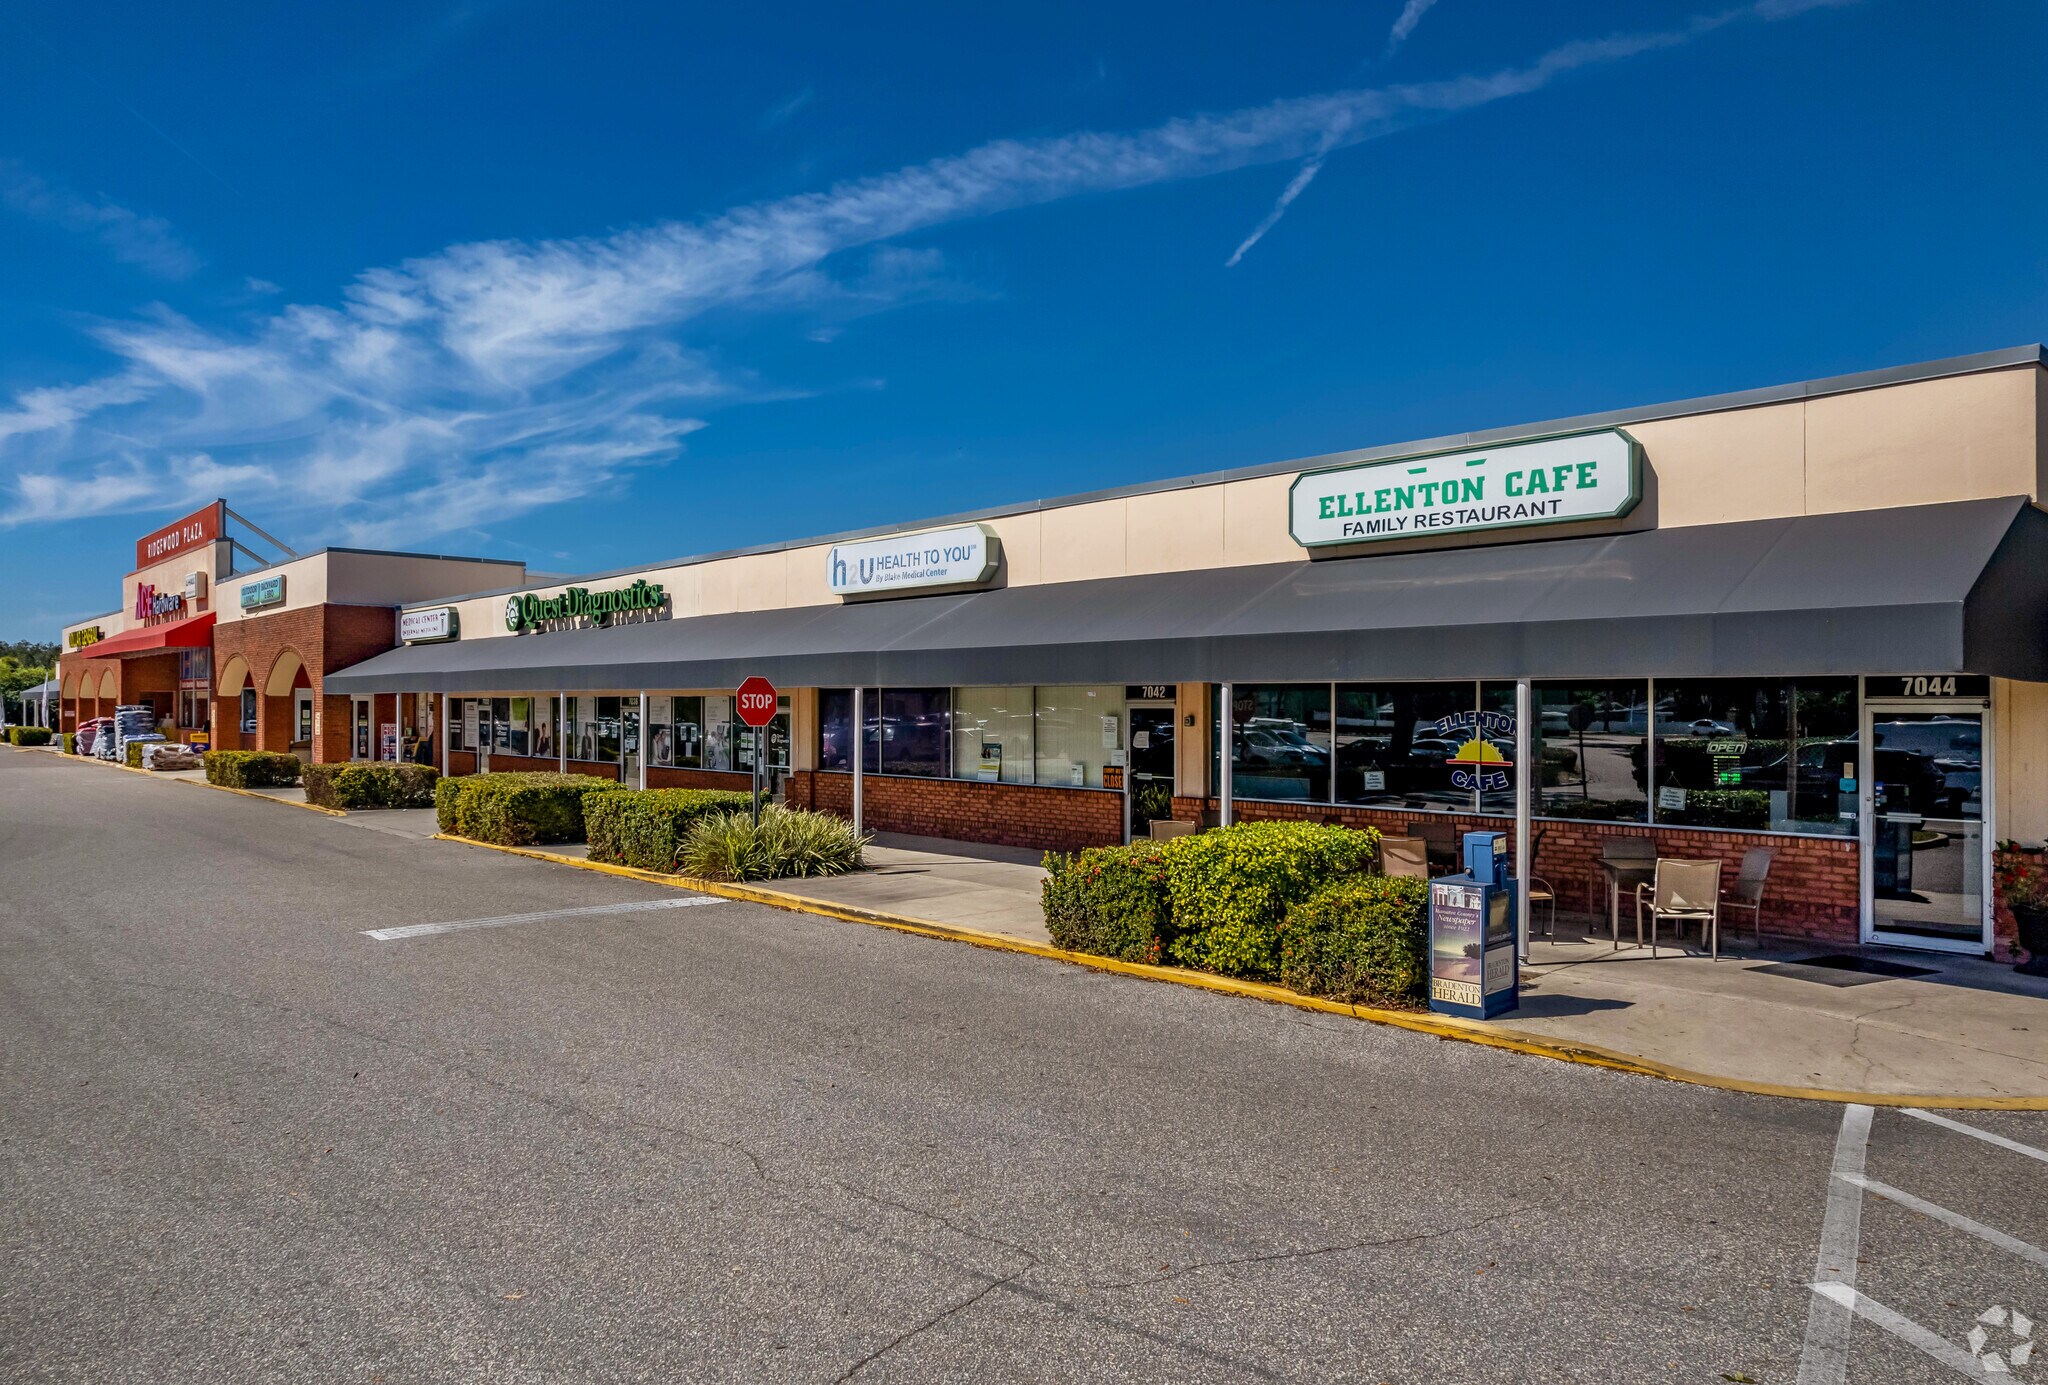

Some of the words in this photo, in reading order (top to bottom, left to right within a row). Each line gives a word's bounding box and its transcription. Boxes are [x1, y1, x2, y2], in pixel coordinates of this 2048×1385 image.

[1318, 475, 1486, 520] ELLENTON
[1505, 460, 1598, 497] CAFE
[1343, 515, 1408, 537] FAMILY
[1413, 499, 1563, 529] RESTAURANT
[147, 531, 180, 558] RIDGEWOOD
[183, 522, 203, 543] PLAZA
[876, 552, 921, 570] HEALTH
[923, 549, 940, 565] TO
[943, 545, 971, 562] YOU
[876, 574, 883, 583] By
[884, 573, 901, 582] Blake
[901, 569, 925, 580] Medical
[925, 568, 948, 577] Center
[136, 582, 155, 620] ACE
[522, 592, 565, 629] Quest
[566, 579, 661, 625] Diagnostics
[402, 616, 421, 626] MEDICAL
[421, 614, 439, 624] CENTER
[1142, 686, 1166, 698] 7042
[1901, 677, 1957, 696] 7044
[741, 693, 773, 709] STOP
[1709, 744, 1744, 753] OPEN
[1451, 770, 1509, 791] CAFE
[1437, 914, 1477, 926] Newspaper
[1486, 964, 1510, 980] HERALD
[1433, 979, 1481, 994] BRADENTON
[1432, 987, 1481, 1005] HERALD
